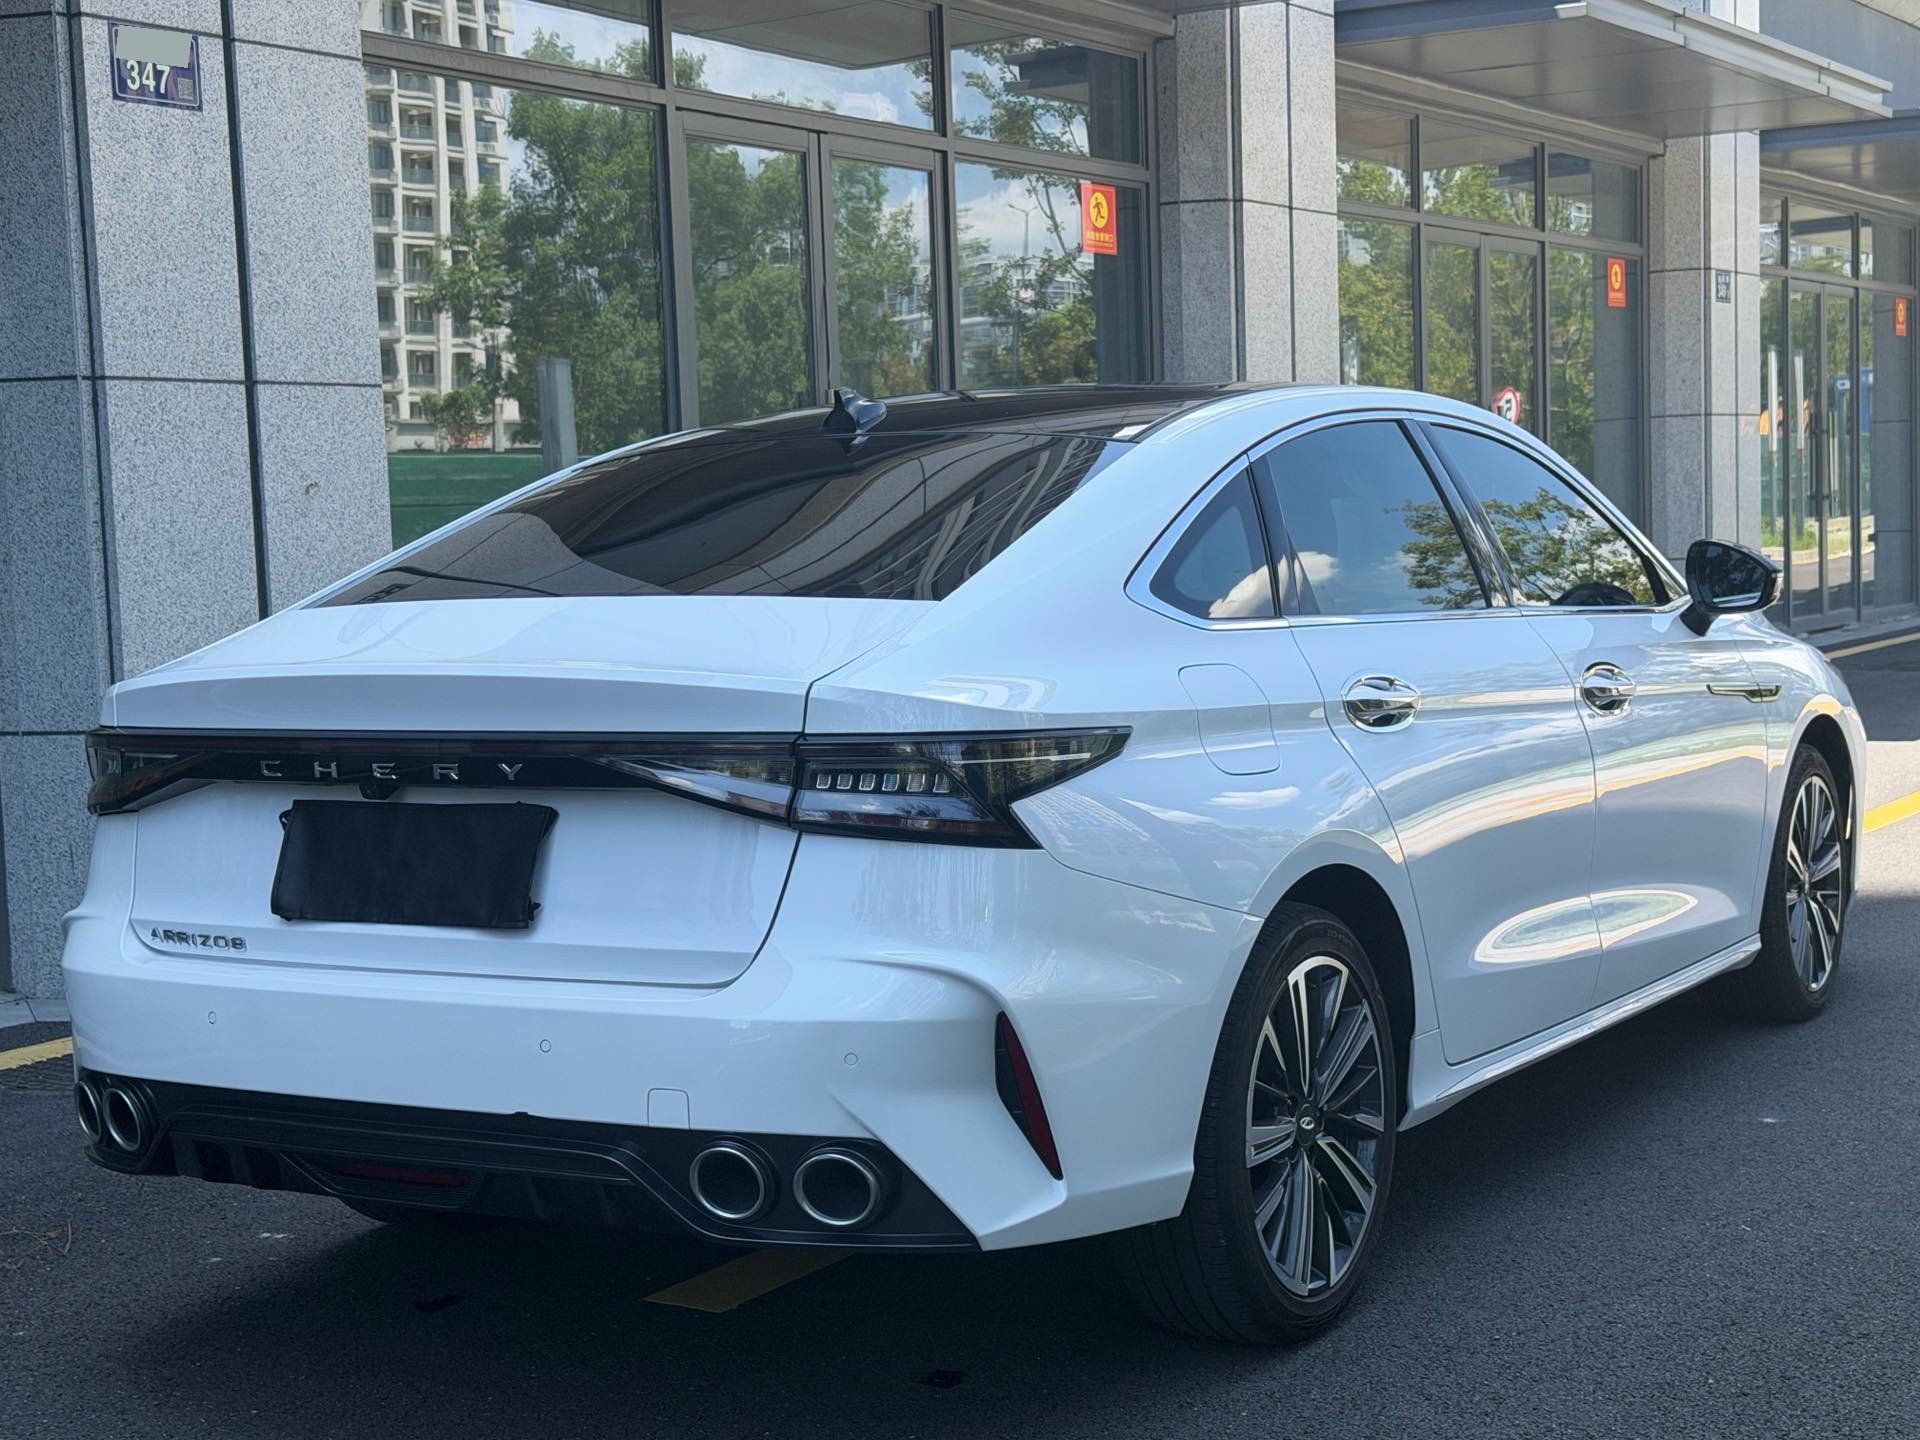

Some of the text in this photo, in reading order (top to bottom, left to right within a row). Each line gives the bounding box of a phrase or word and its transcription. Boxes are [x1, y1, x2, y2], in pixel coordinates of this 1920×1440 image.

[126, 59, 170, 94] 347
[259, 759, 523, 781] CHERY
[150, 927, 248, 952] ARRIZO8
